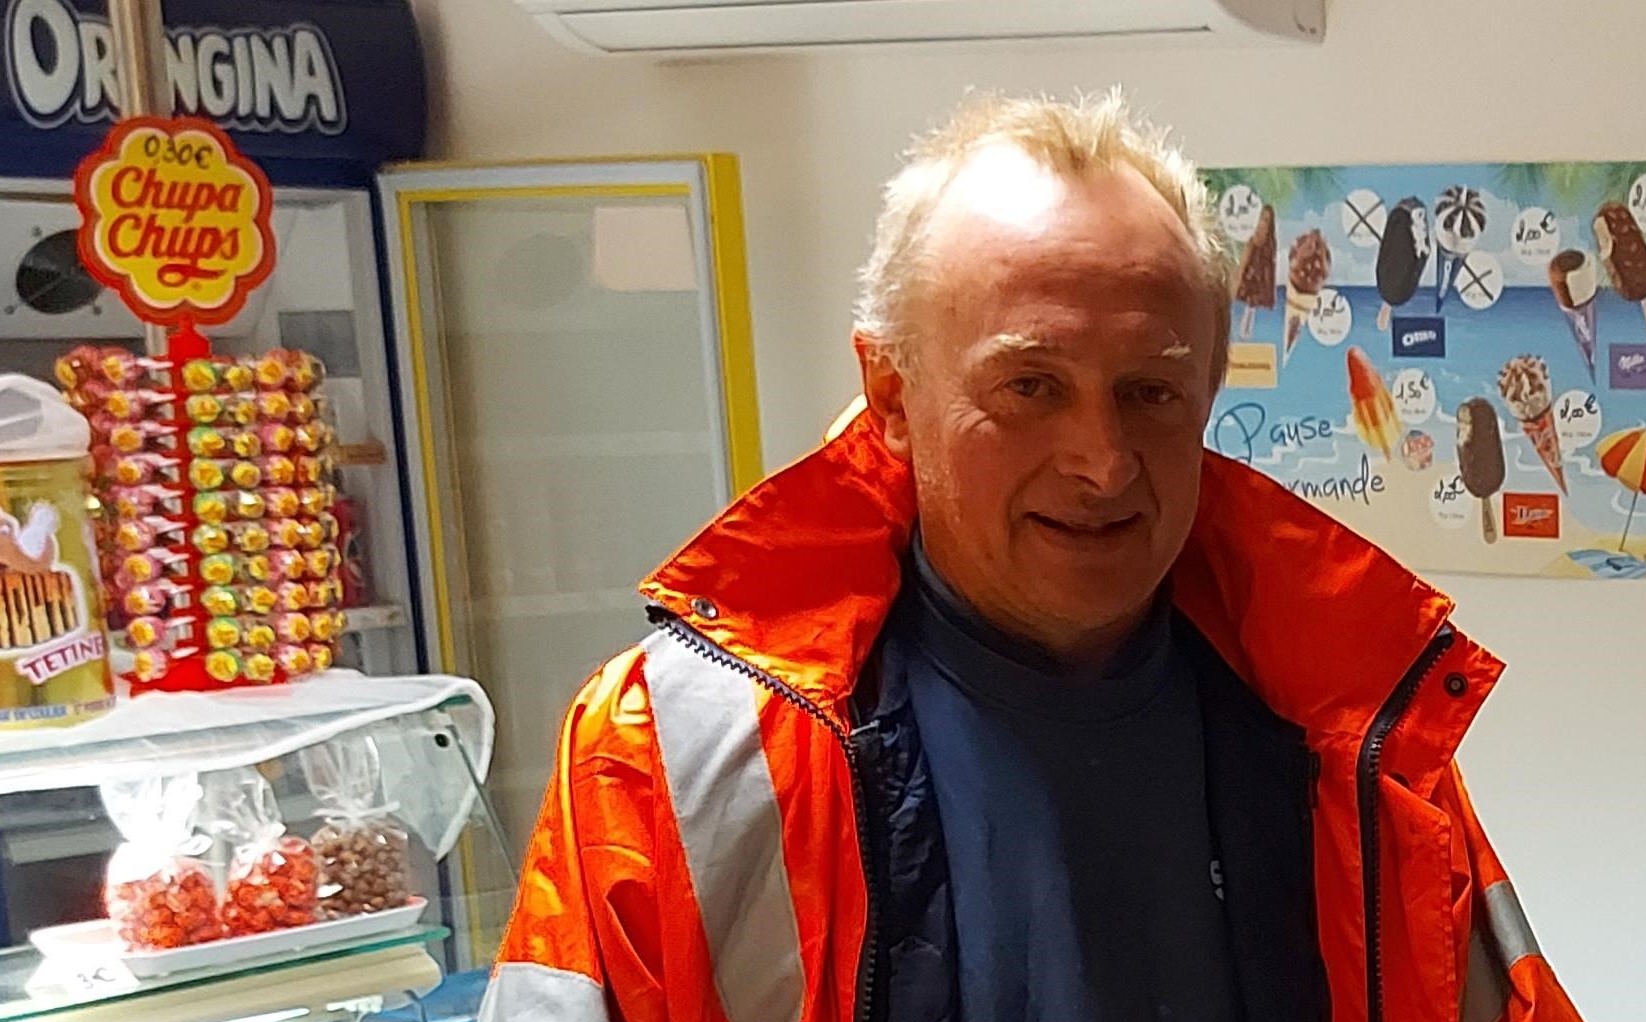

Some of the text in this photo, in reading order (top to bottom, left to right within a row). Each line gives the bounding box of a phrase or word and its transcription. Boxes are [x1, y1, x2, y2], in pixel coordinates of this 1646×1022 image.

[12, 0, 339, 121] ORNGINA
[111, 165, 245, 223] Chupa
[107, 213, 240, 287] Chups
[1214, 402, 1334, 463] Pause
